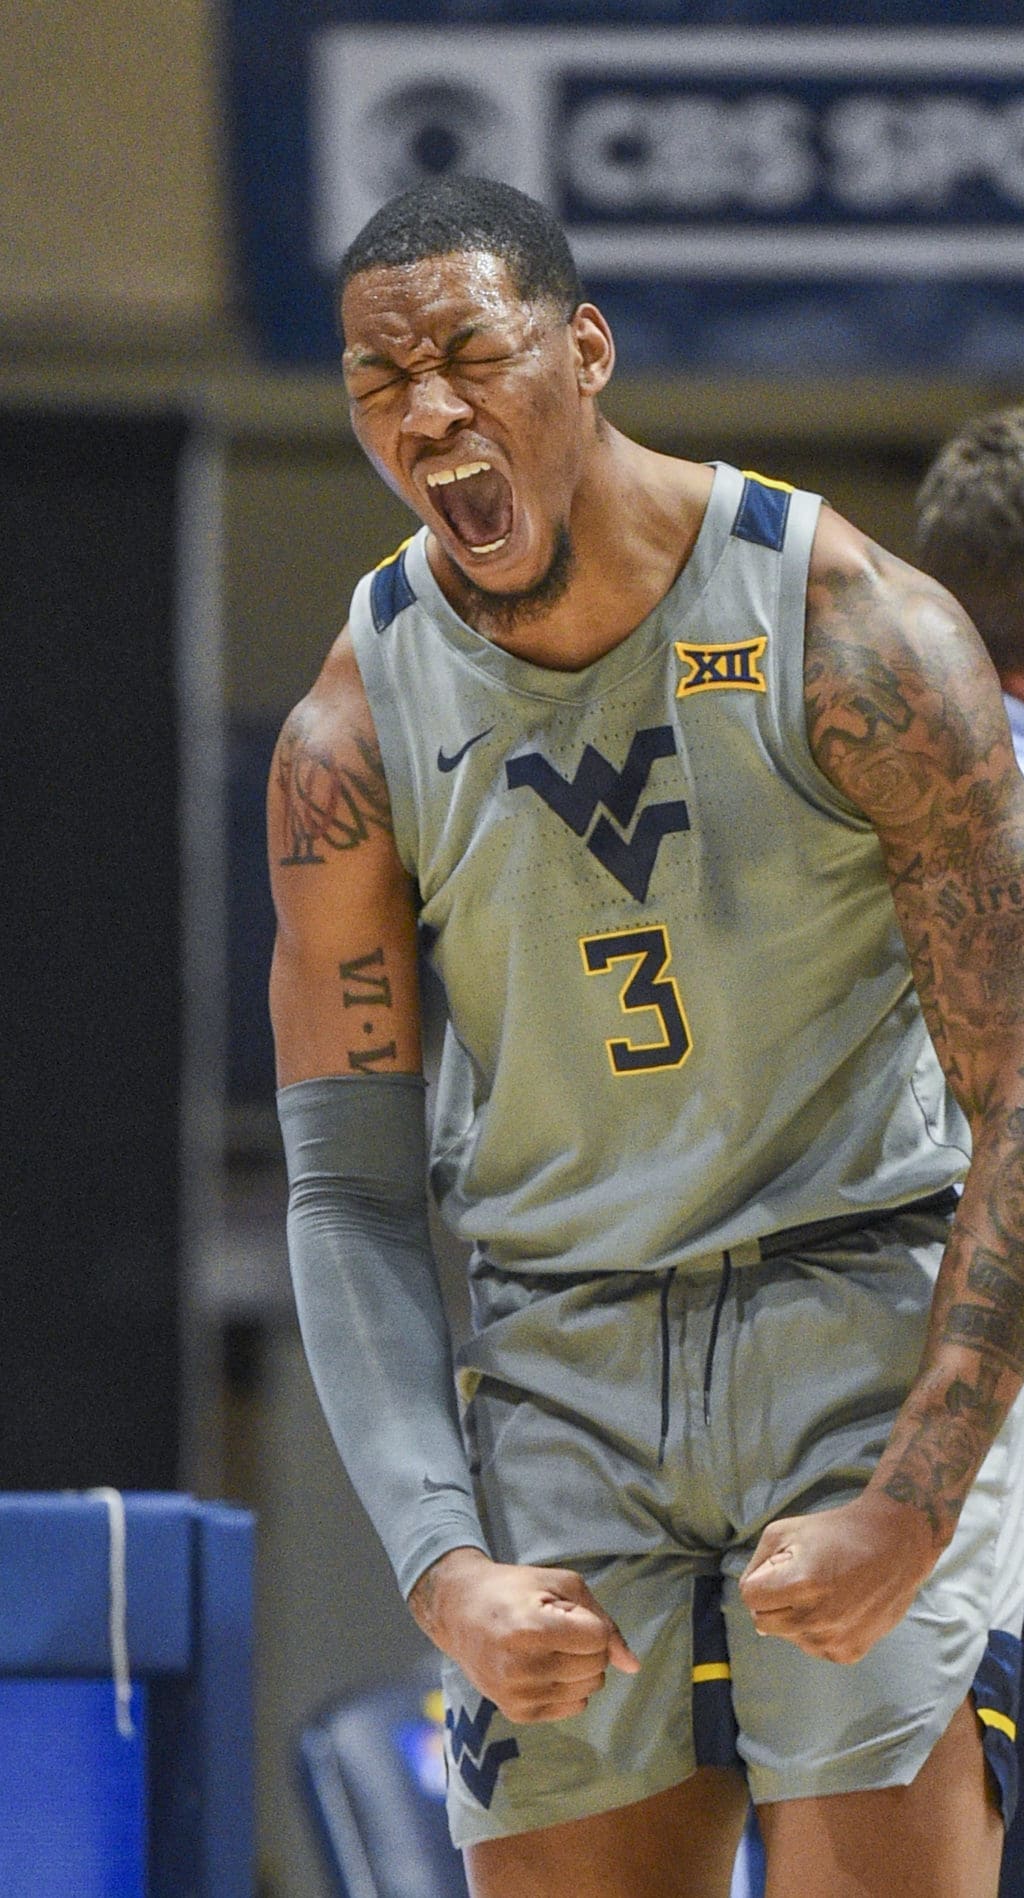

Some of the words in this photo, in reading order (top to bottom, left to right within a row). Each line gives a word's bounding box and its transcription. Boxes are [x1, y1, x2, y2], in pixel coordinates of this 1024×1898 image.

[563, 95, 803, 206] CBS
[681, 643, 763, 691] XII
[579, 924, 693, 1077] 3
